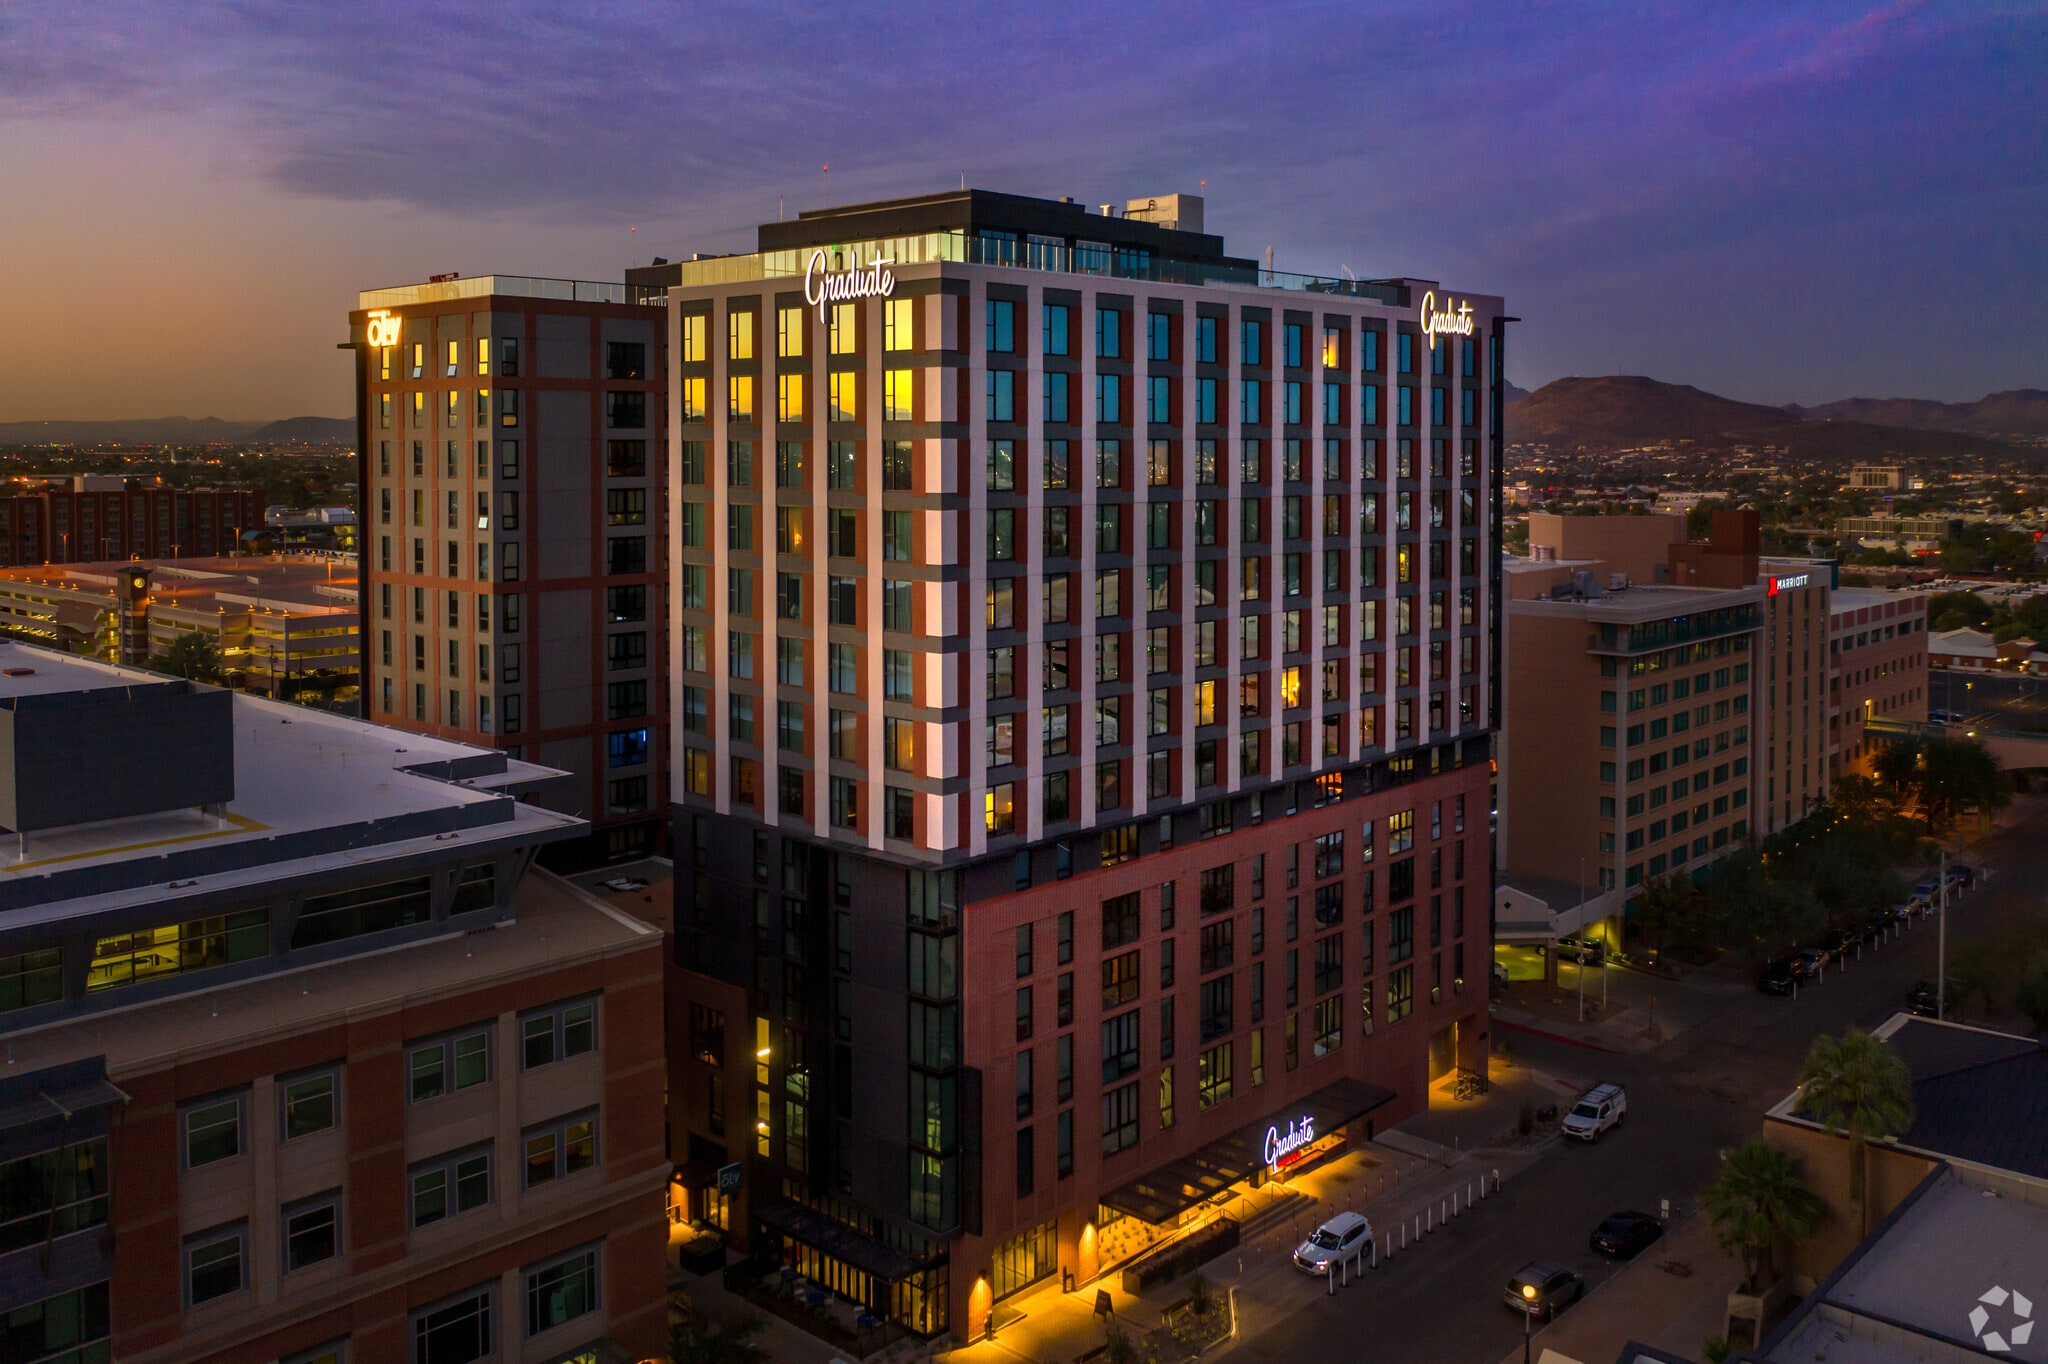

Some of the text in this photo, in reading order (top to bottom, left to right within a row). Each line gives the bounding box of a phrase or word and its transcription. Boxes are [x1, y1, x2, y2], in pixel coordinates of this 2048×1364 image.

[805, 250, 895, 324] Graduate
[1420, 290, 1474, 351] Graduate
[1777, 575, 1808, 590] MARRIOTT
[1264, 1116, 1314, 1173] Graduate
